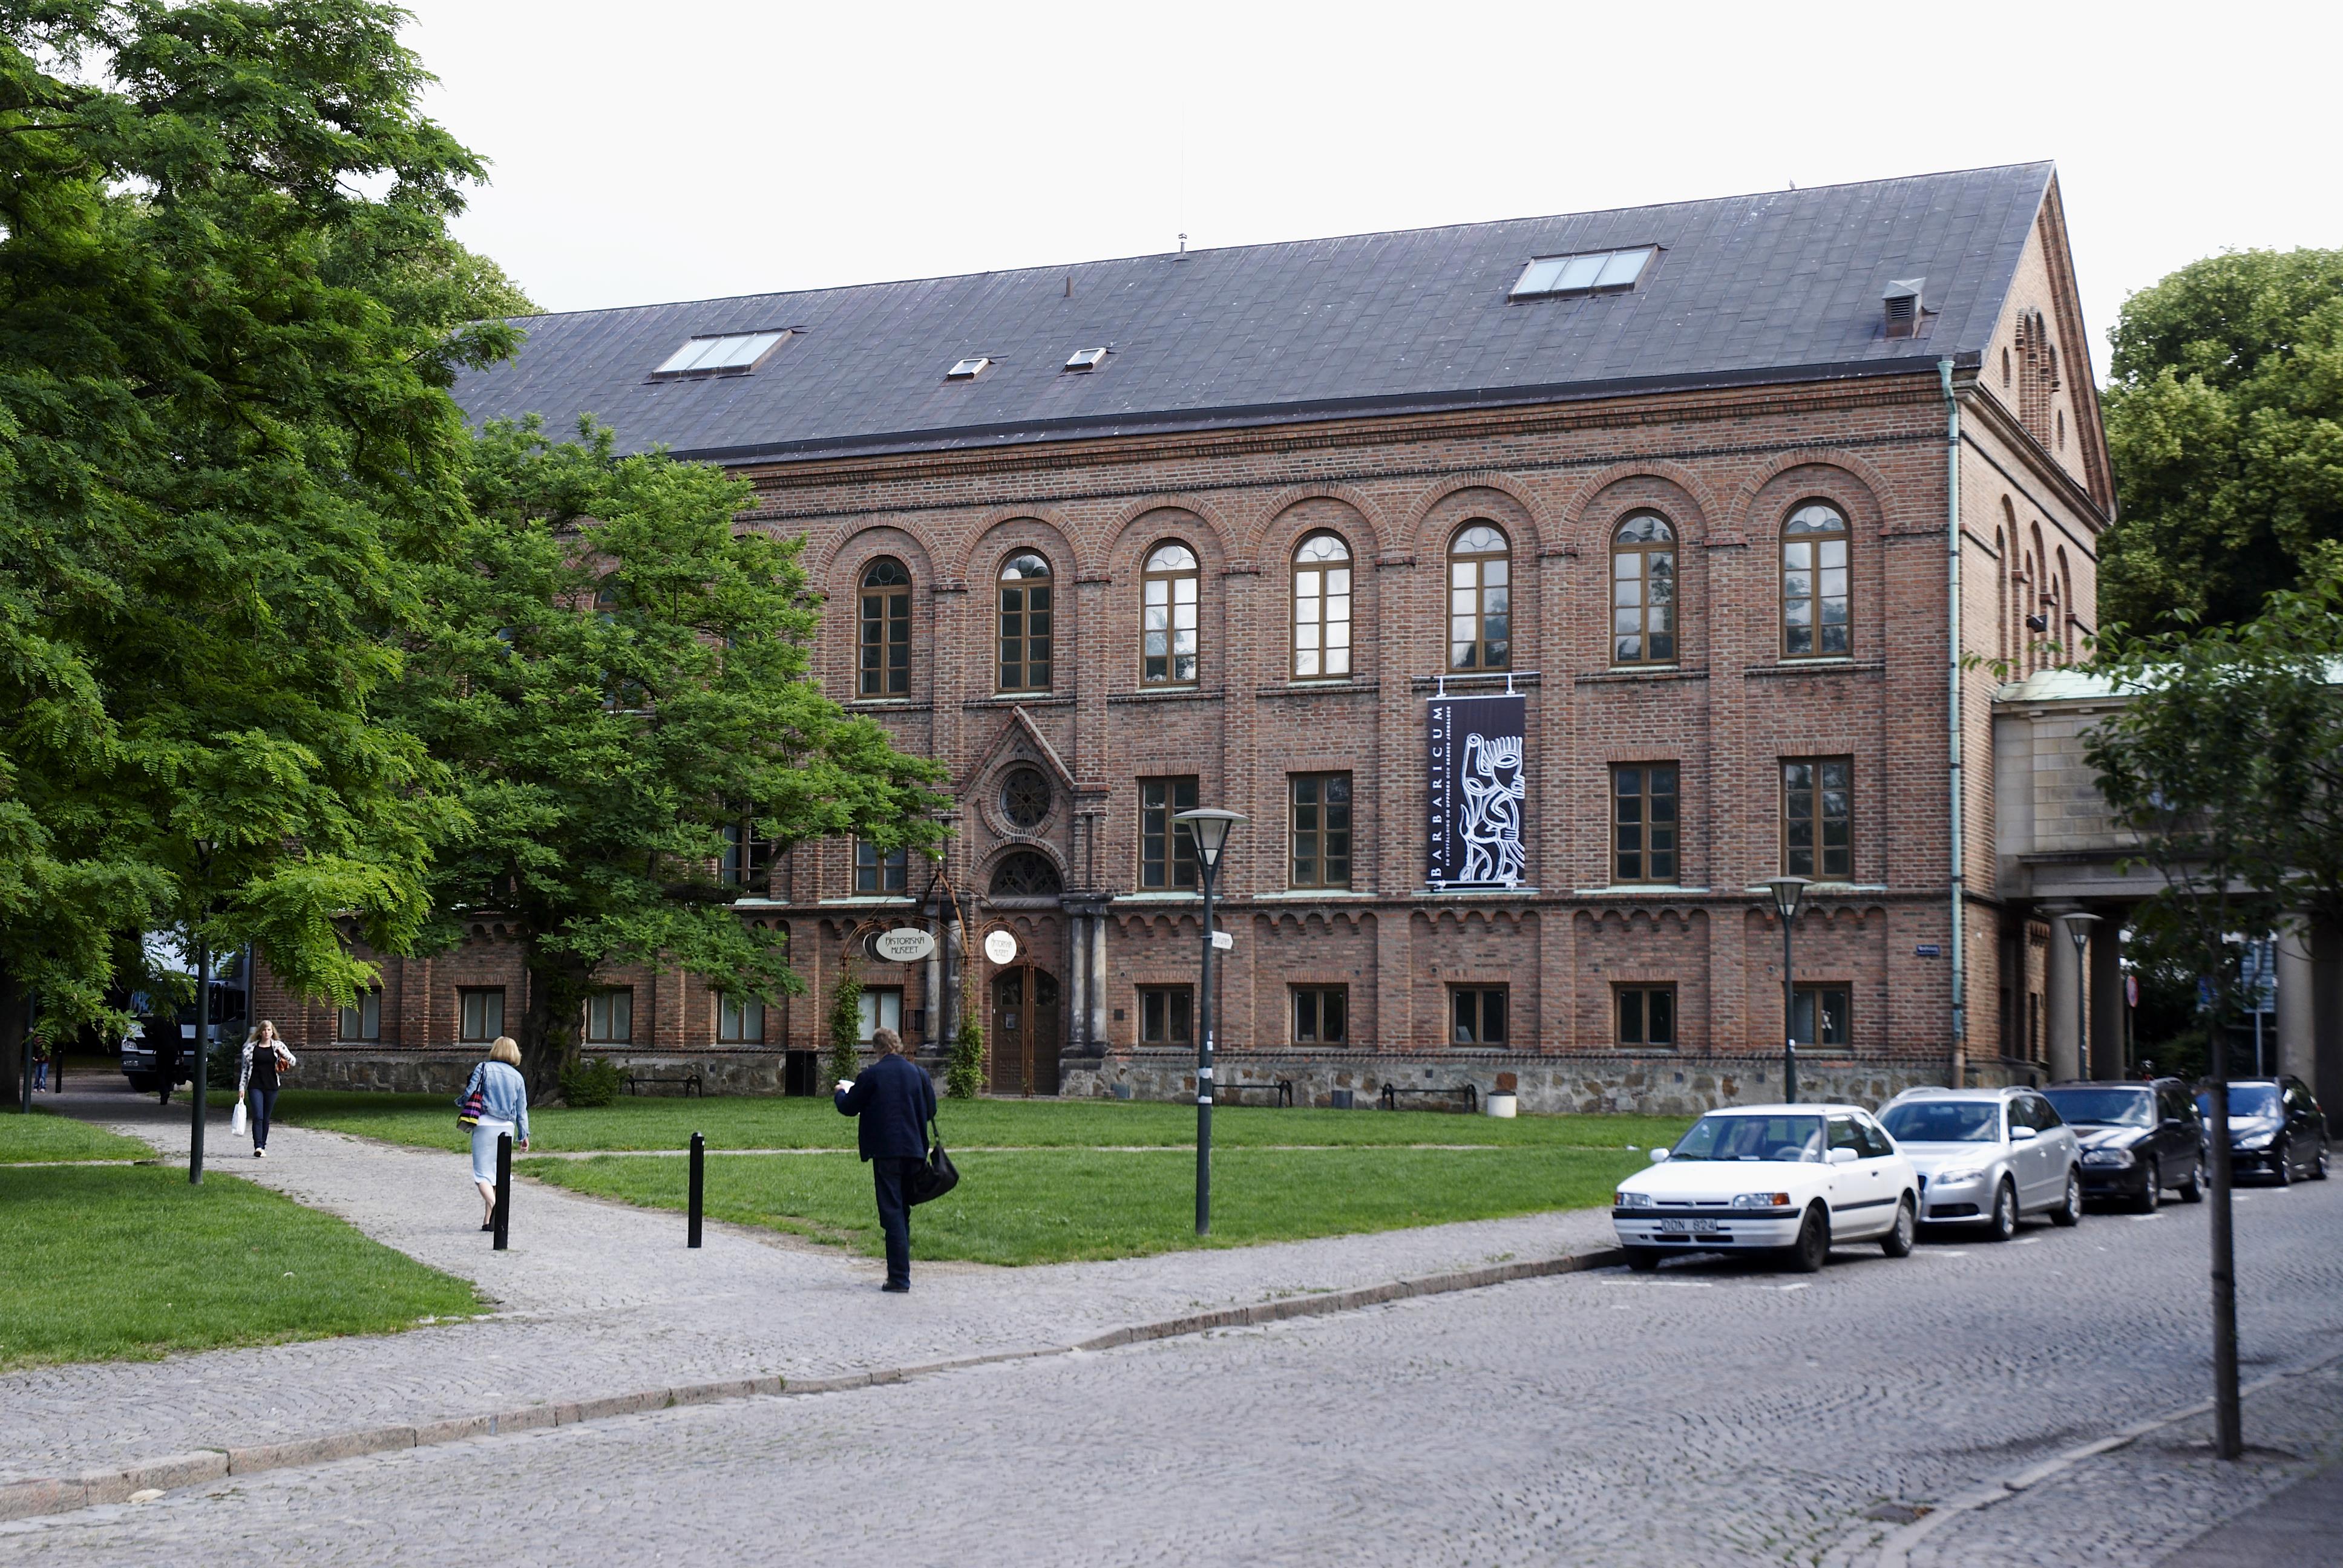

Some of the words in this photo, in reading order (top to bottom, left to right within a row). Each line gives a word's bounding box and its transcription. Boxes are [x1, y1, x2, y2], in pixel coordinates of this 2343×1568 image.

[1431, 707, 1443, 877] BARBARICUM
[885, 936, 925, 947] HISTORISKA
[1693, 1219, 1715, 1231] 824
